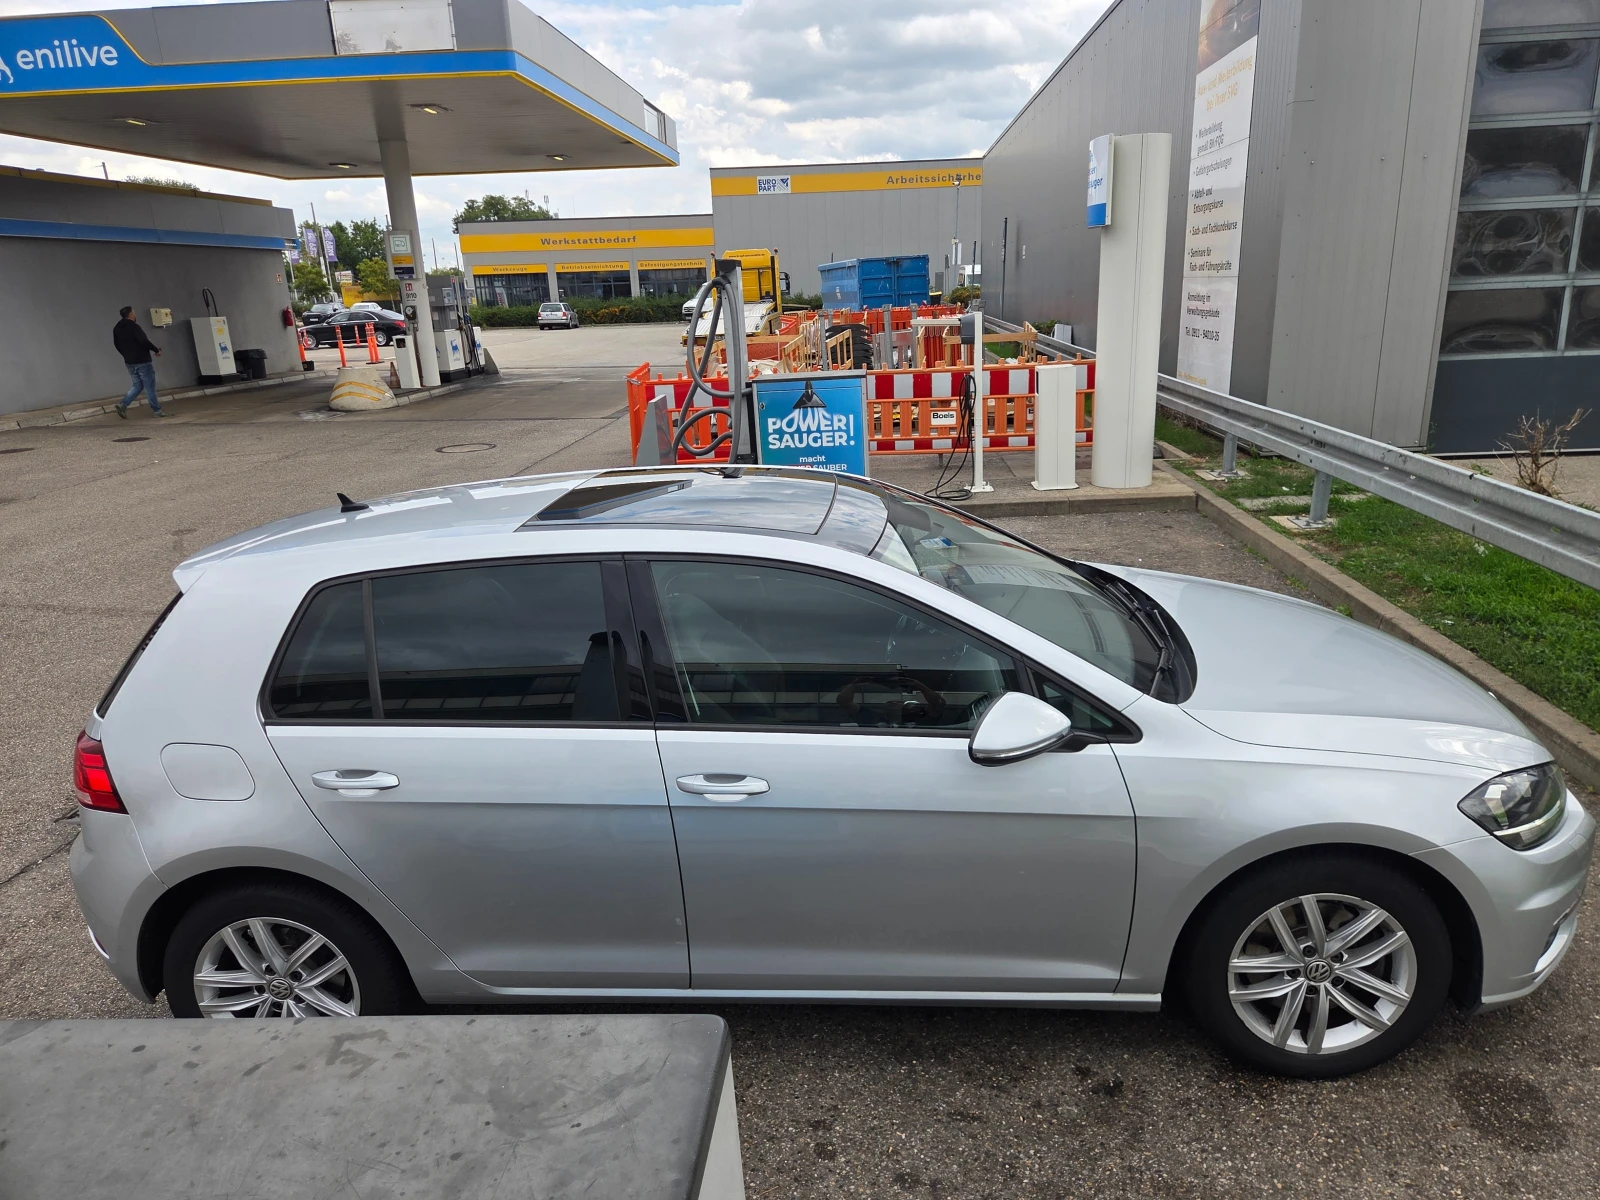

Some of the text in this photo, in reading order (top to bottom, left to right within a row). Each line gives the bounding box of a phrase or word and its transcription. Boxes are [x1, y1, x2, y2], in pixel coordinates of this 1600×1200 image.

[16, 39, 118, 70] enilive
[886, 172, 982, 185] Arbeitssichrhe
[1193, 199, 1224, 214] Entsorgungskurse
[540, 236, 637, 246] Werkstattbedarf
[1190, 247, 1206, 258] Seminare
[1198, 260, 1206, 271] und
[1187, 292, 1205, 304] Anmeldung
[799, 455, 827, 463] macht
